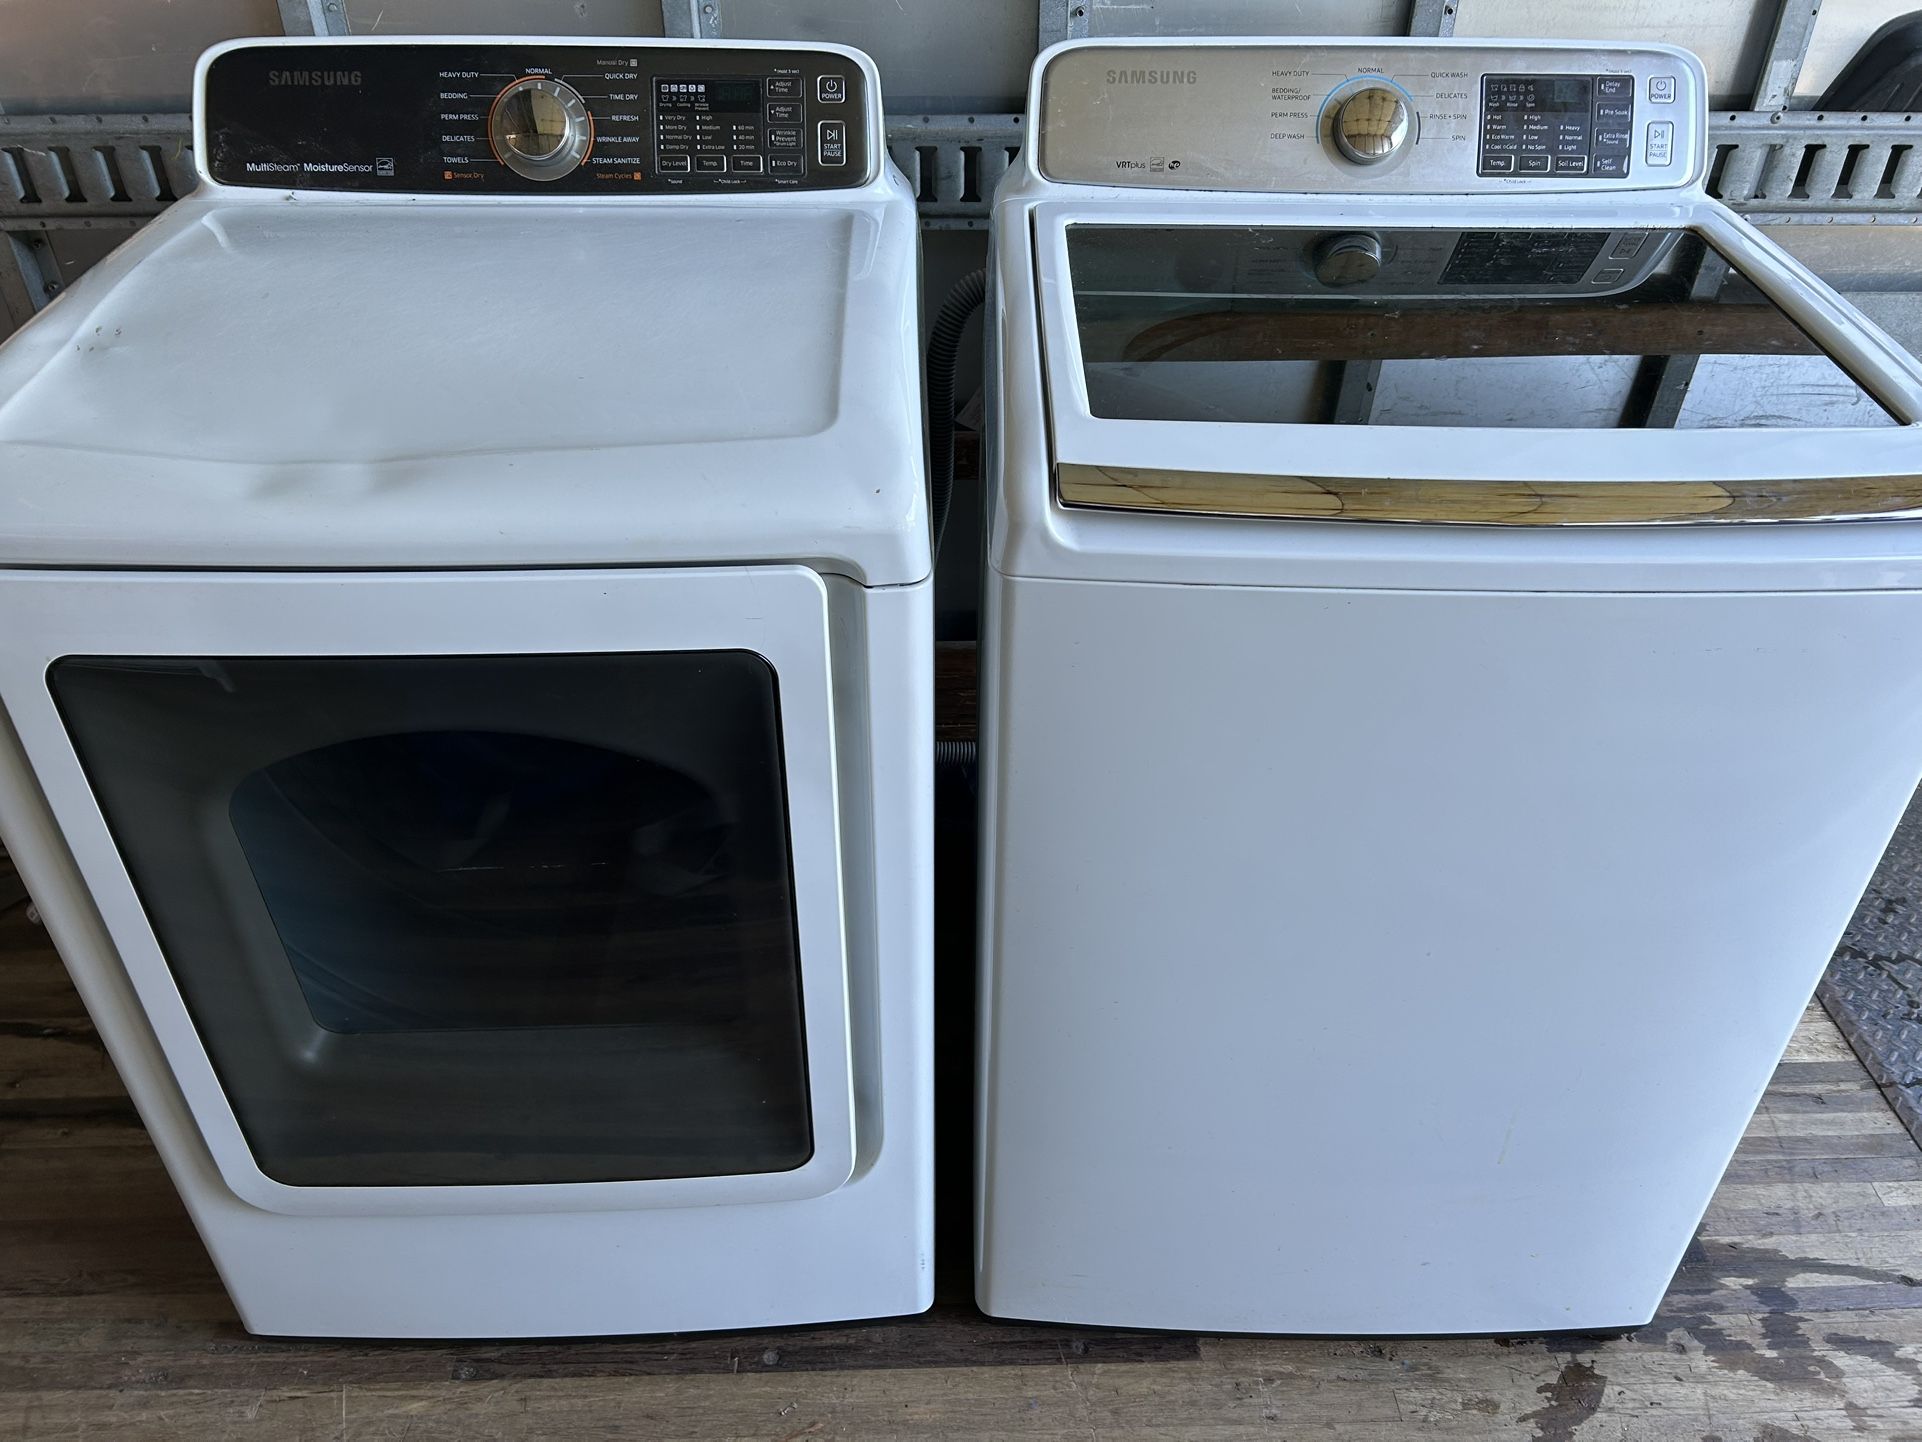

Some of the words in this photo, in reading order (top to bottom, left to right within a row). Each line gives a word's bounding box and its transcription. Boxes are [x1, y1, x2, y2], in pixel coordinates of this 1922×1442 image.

[269, 71, 362, 86] SAMSUNG
[1106, 70, 1197, 85] SAMSUNG
[304, 163, 372, 172] MoistureSensor
[1116, 161, 1146, 170] VRTplus
